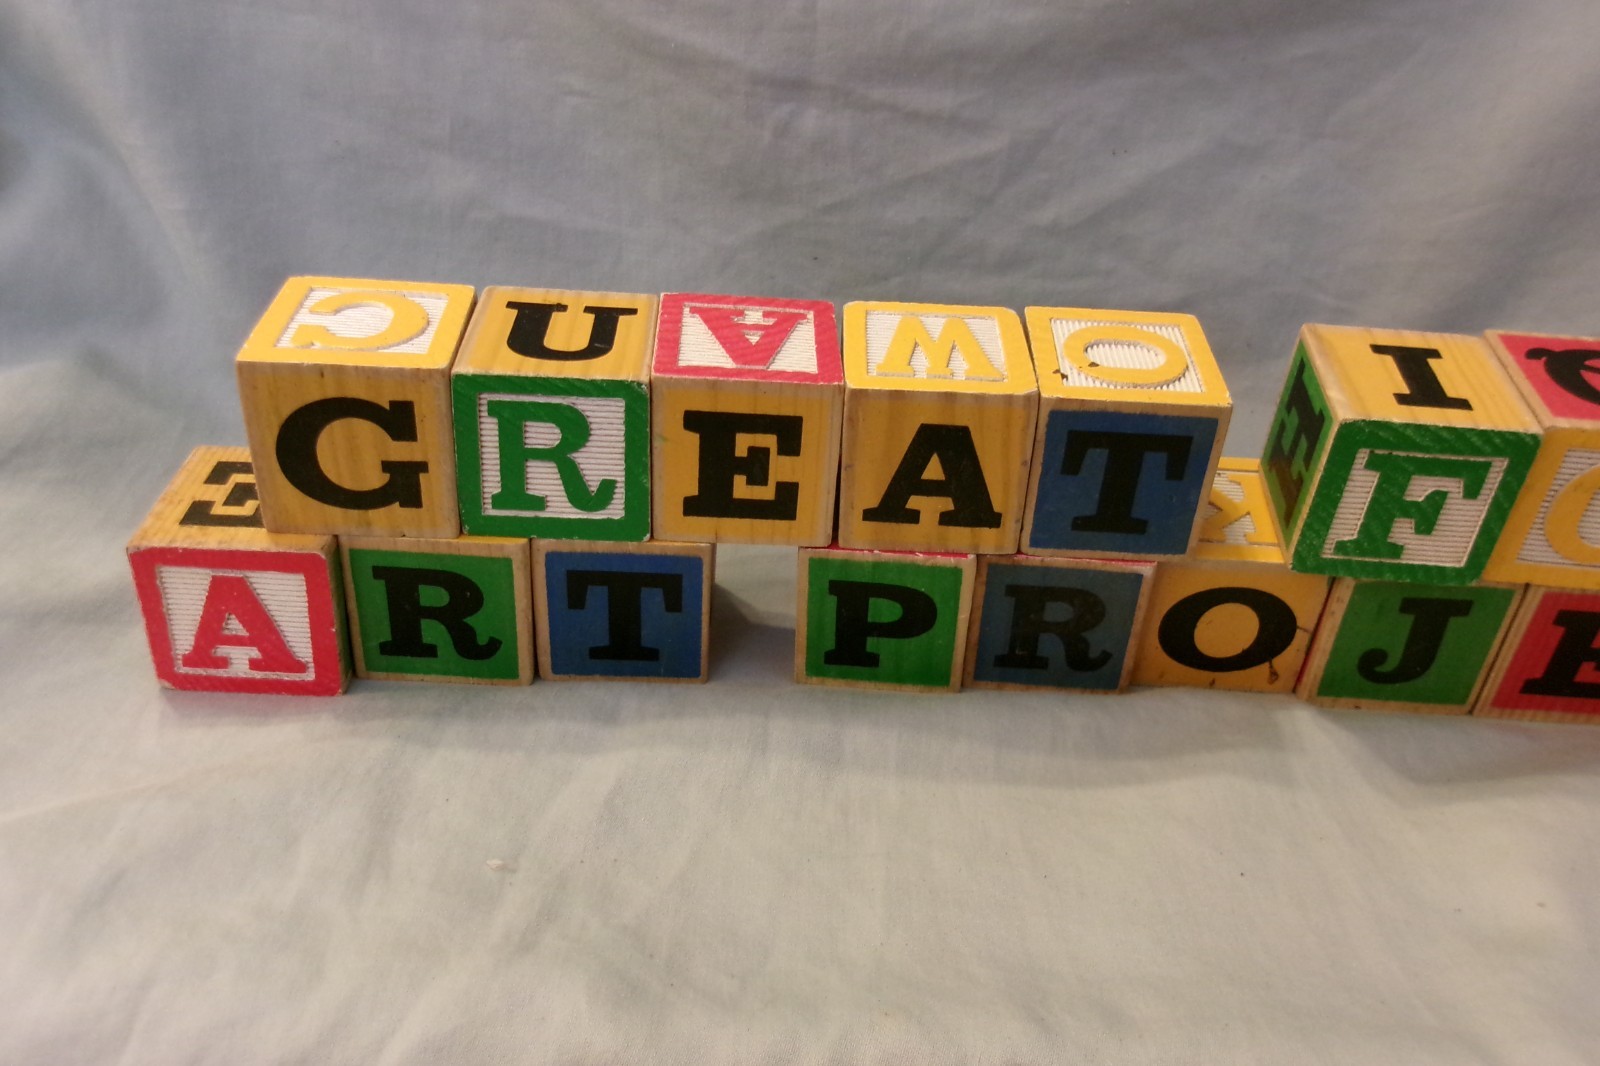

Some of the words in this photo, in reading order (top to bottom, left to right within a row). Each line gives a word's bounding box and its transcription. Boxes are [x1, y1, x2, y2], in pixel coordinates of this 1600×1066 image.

[289, 292, 430, 351] C
[505, 300, 638, 361] U
[687, 306, 813, 369] A
[1062, 323, 1188, 387] O
[1369, 343, 1474, 411] I
[276, 396, 1194, 535] GREAT
[181, 565, 684, 674] ART
